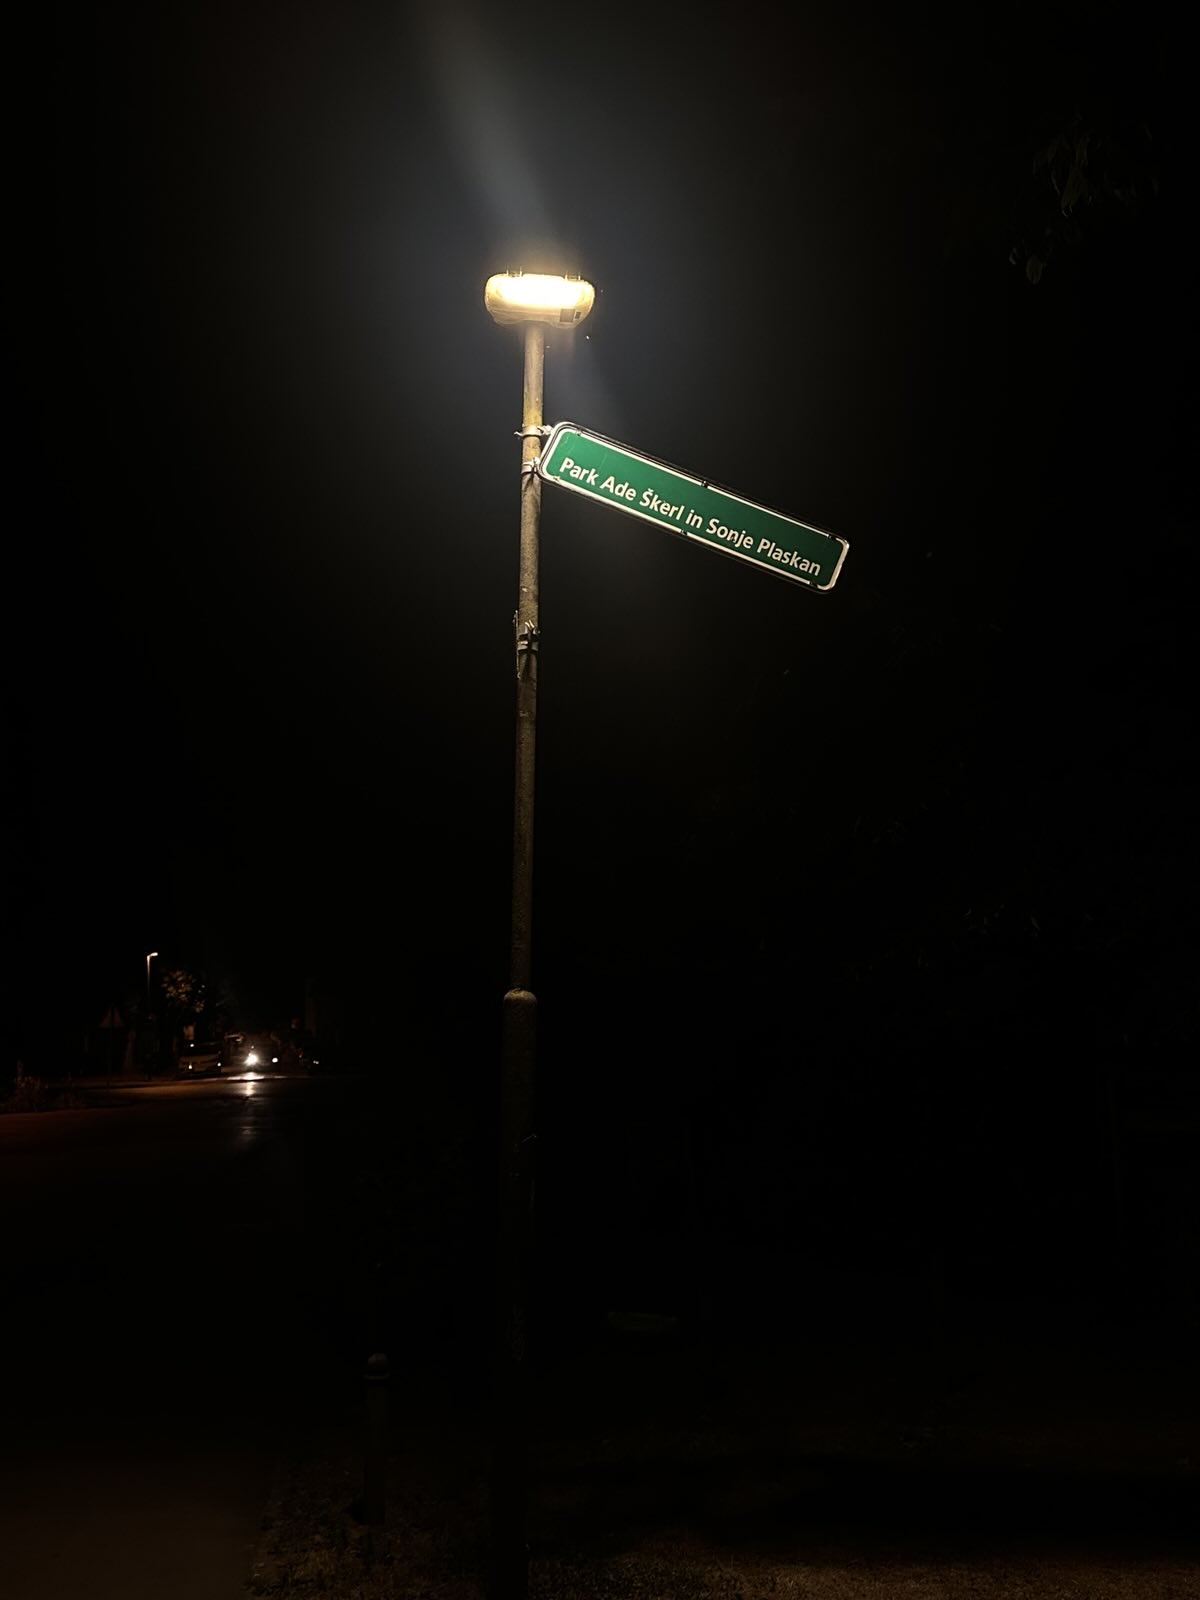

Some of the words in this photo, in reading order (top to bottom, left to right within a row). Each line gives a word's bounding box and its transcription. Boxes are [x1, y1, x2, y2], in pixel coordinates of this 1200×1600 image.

[559, 457, 599, 486] Park
[600, 476, 637, 502] Ade
[639, 488, 685, 520] Škerl
[686, 509, 703, 529] in
[706, 518, 754, 549] Sonje
[757, 539, 822, 577] Plaskan
